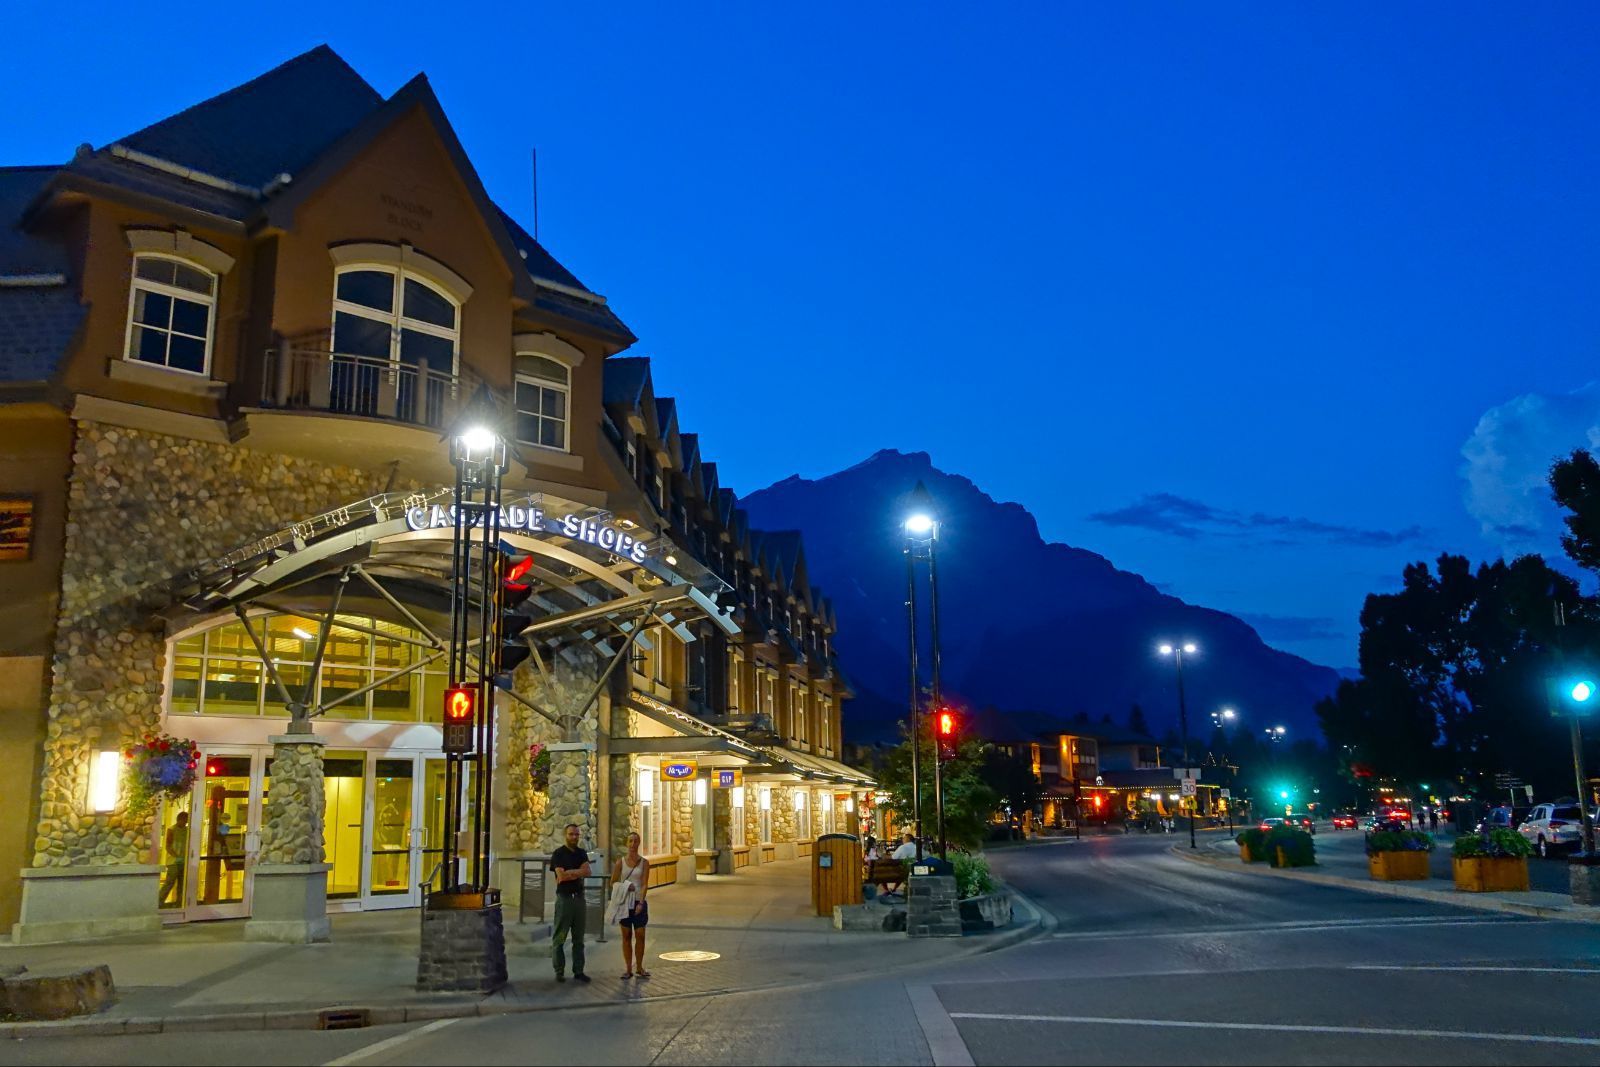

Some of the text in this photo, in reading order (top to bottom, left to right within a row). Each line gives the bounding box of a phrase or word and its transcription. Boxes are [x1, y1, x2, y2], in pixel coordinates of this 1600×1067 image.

[561, 513, 648, 564] SHOPS
[721, 775, 732, 784] GAP
[1184, 785, 1195, 793] 30
